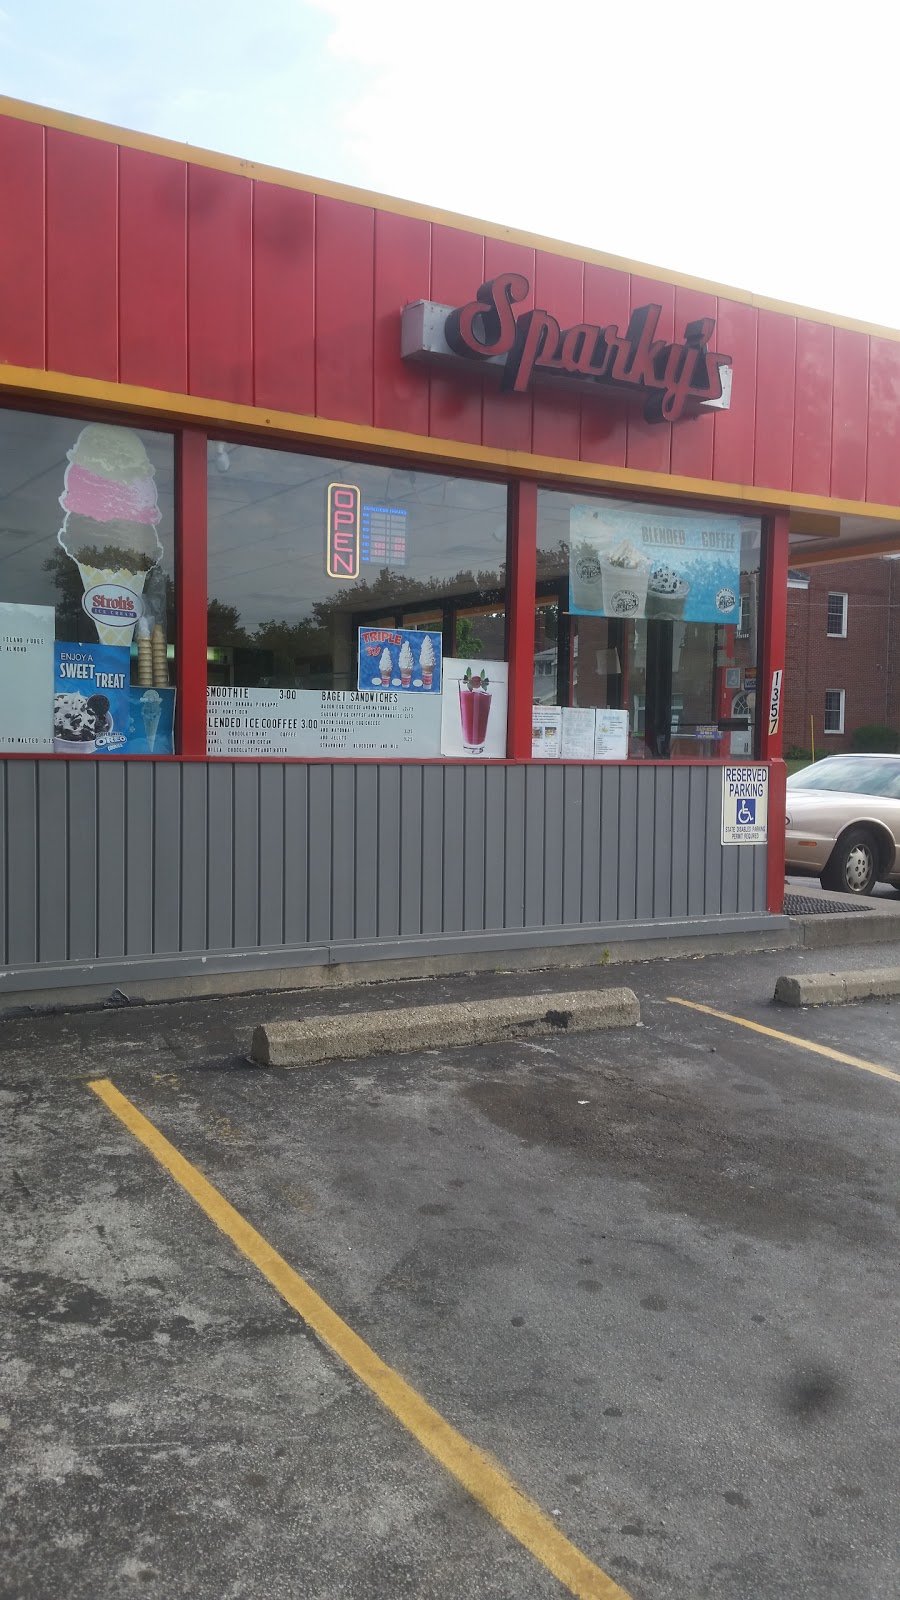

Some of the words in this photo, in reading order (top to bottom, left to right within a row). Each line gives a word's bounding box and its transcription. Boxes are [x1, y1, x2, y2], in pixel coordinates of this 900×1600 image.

[447, 272, 732, 422] Sparky's
[333, 489, 355, 573] OPEN
[641, 526, 686, 546] BLENDED
[701, 531, 736, 550] COFFEE
[92, 594, 135, 611] Stroh's
[362, 631, 402, 646] TRIPLE
[60, 653, 86, 662] ENJOY
[59, 662, 95, 679] SWEET
[95, 672, 125, 688] TREAT
[206, 687, 249, 698] SMOOTHIE
[279, 689, 297, 700] 3.00
[350, 692, 399, 703] SANDWICHES
[769, 671, 781, 735] 1357
[206, 717, 241, 728] LENDED
[245, 718, 260, 728] ICE
[301, 719, 319, 730] 3.00
[95, 735, 127, 747] OREO
[725, 768, 768, 782] RESERVED
[729, 783, 764, 798] PARKING
